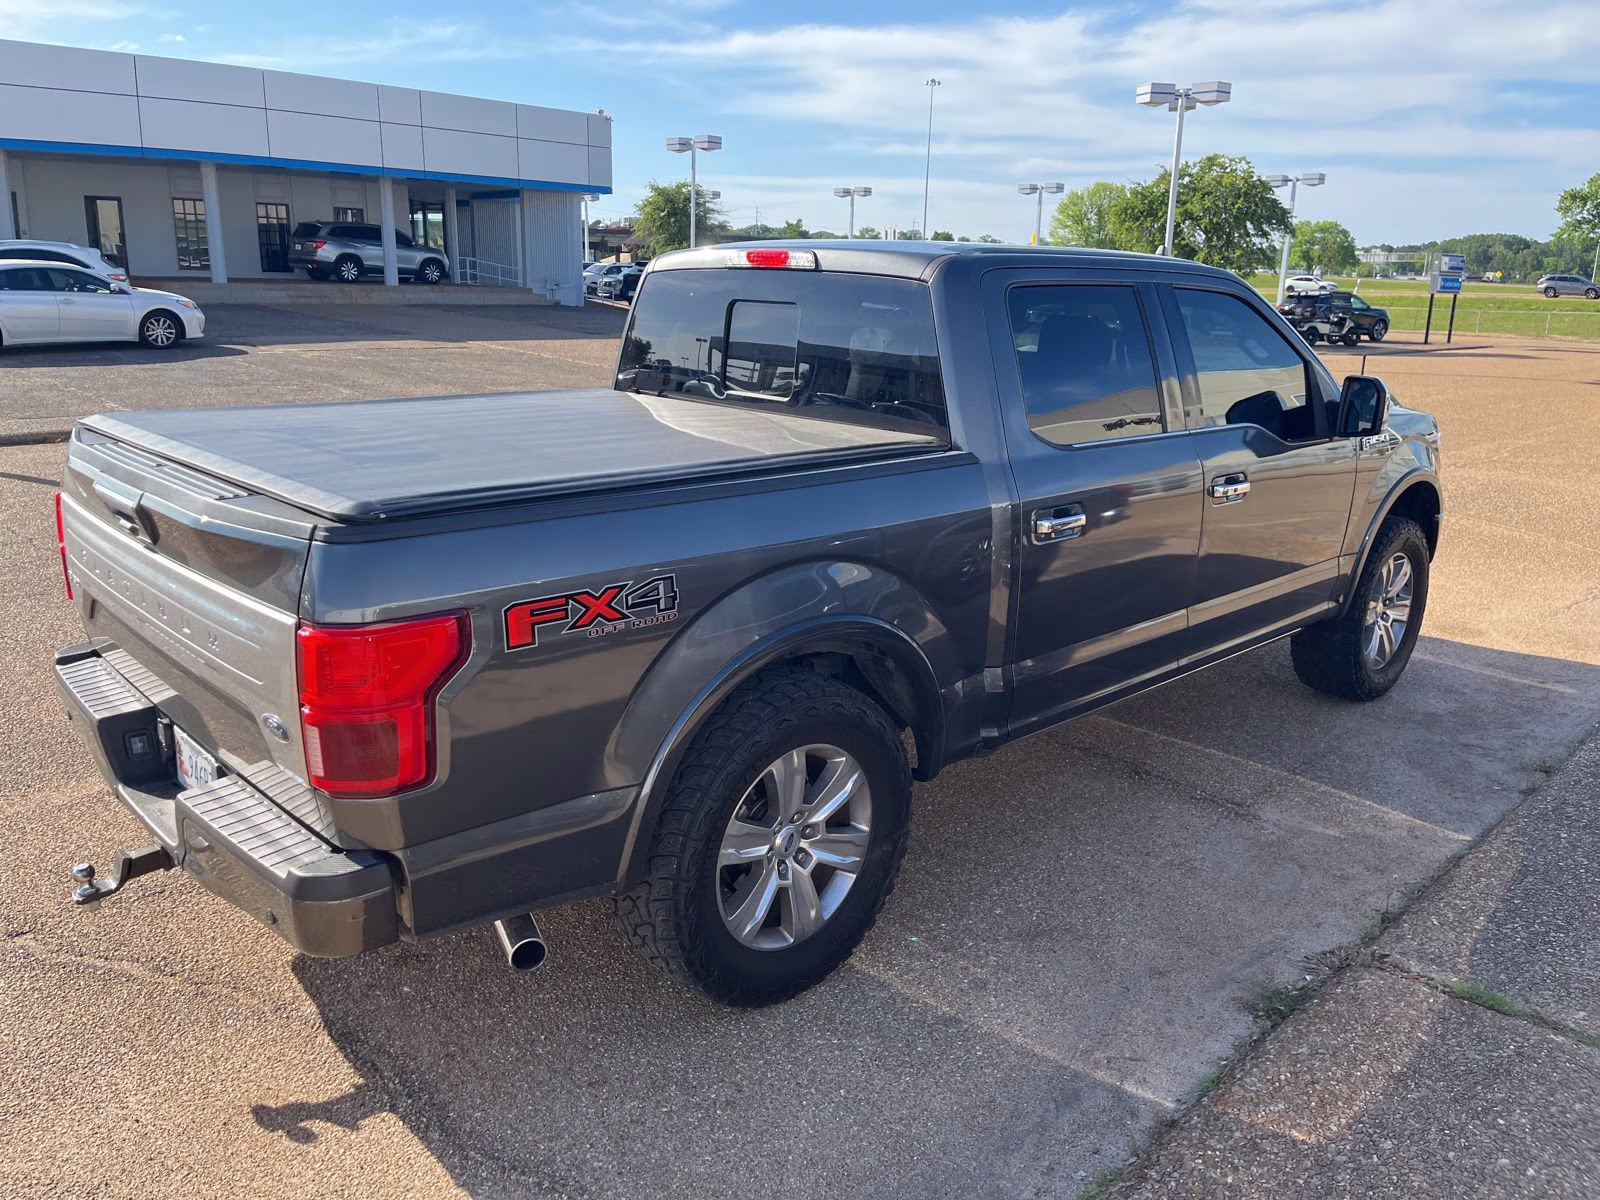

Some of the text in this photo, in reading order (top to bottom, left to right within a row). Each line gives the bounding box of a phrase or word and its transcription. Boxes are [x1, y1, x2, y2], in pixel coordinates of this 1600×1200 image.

[502, 574, 679, 653] FX4
[587, 612, 678, 638] OFF ROAD
